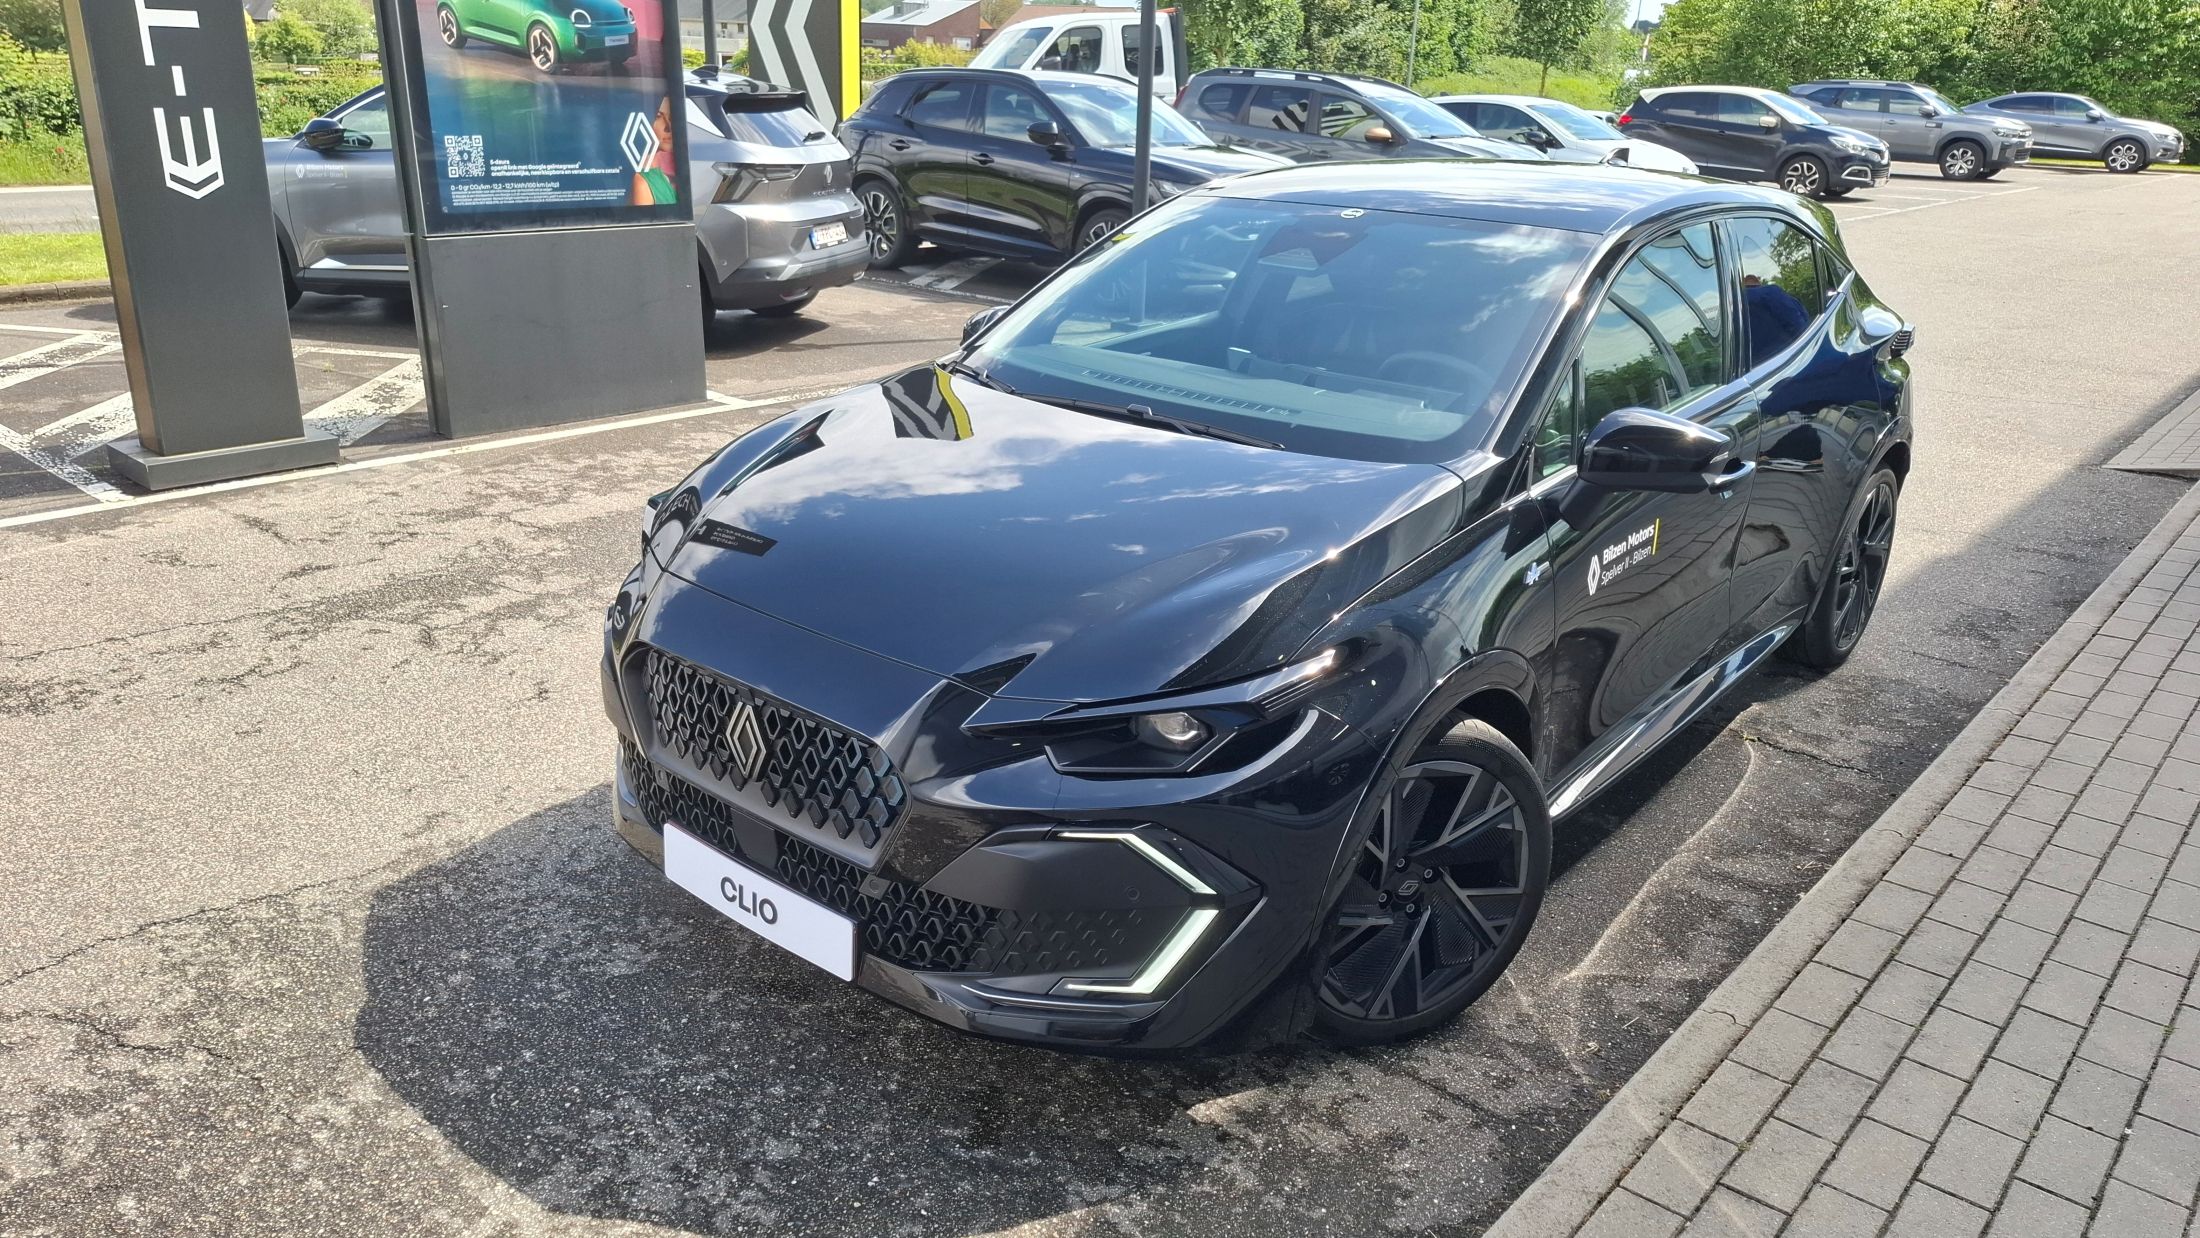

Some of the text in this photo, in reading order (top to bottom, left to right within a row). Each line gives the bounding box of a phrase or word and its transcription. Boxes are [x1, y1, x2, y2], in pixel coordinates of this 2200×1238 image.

[1602, 524, 1655, 565] Bilzen Motors
[1600, 561, 1625, 586] Spelver
[1632, 545, 1652, 565] Bilzen
[720, 876, 778, 925] CLIO
